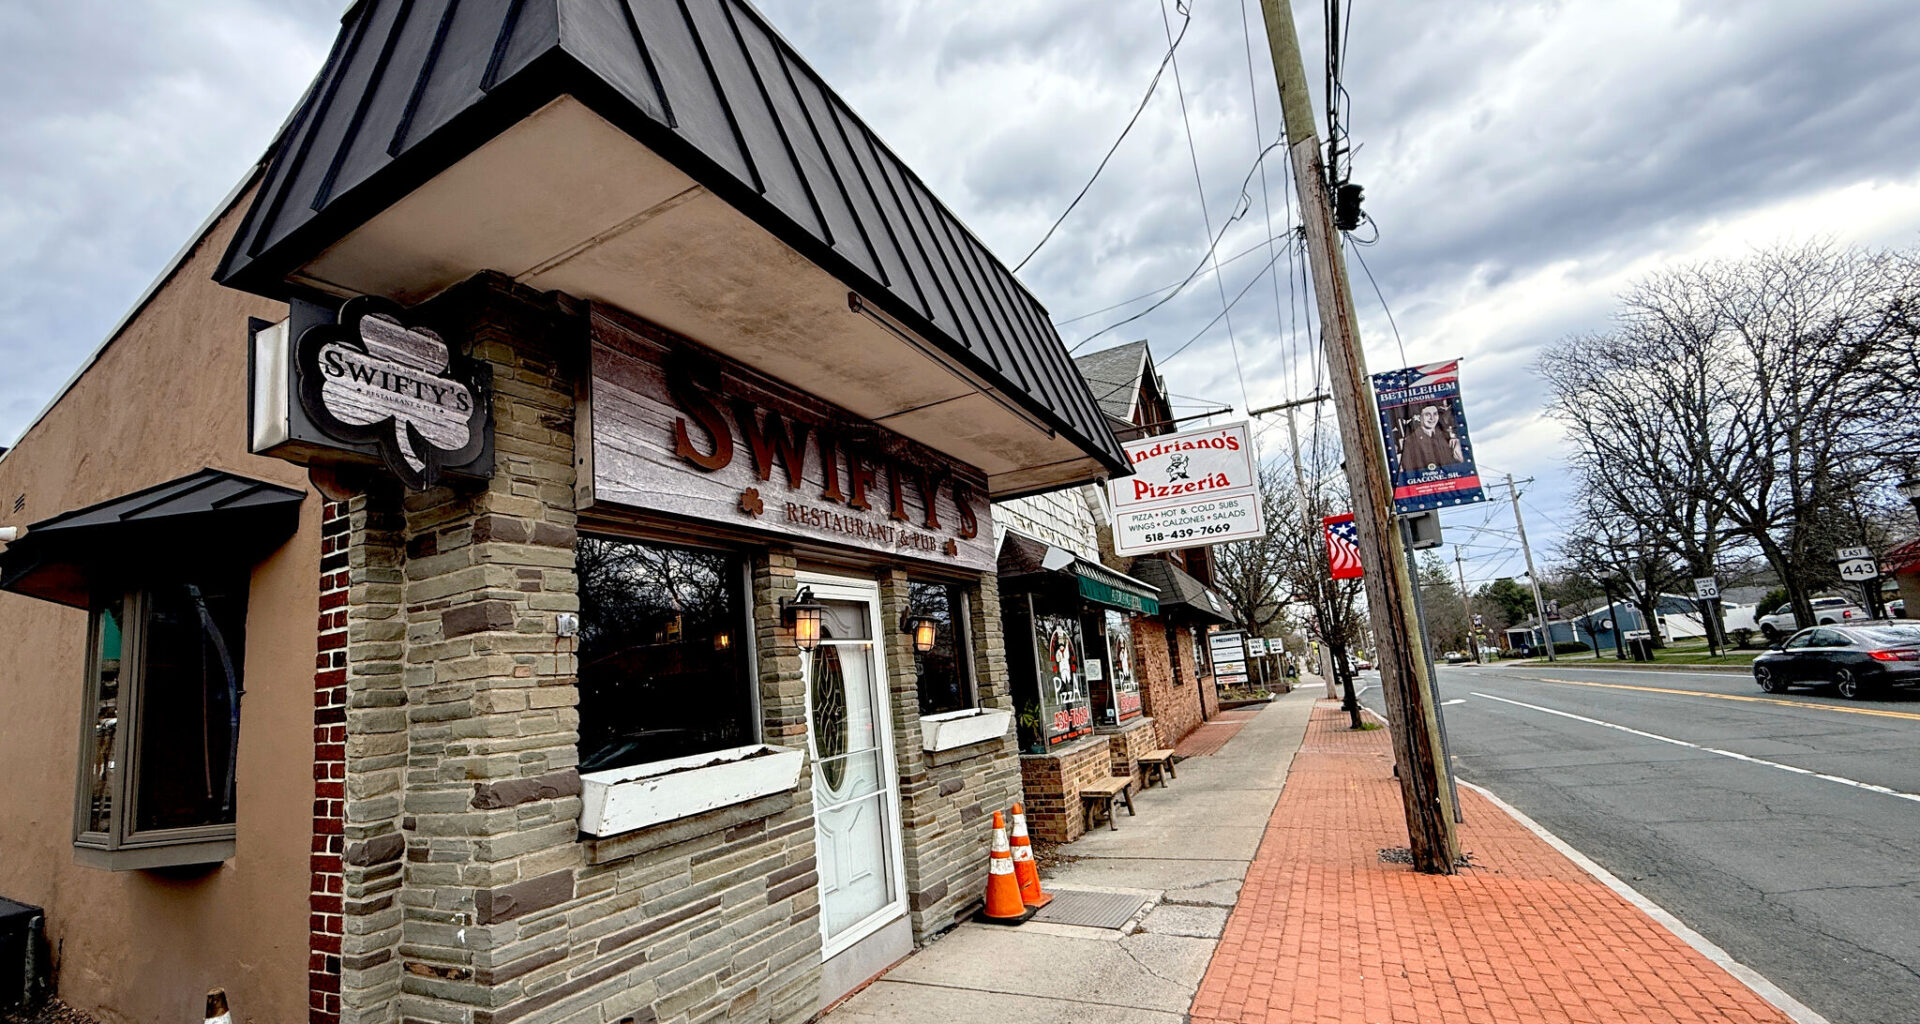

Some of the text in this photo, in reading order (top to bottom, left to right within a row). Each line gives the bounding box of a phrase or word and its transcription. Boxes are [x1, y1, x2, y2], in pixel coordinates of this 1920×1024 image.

[325, 350, 469, 412] SWIFTY'S
[1380, 381, 1456, 402] BETHLEHEM
[366, 390, 414, 407] RESTAURANT
[423, 404, 436, 413] PUB
[1402, 393, 1436, 404] HONORS
[1132, 472, 1231, 500] Pizzeria
[1128, 509, 1246, 533] WINGS CALZONES SALADS
[1132, 500, 1239, 522] PIZZA HOT & COLD SUBS
[786, 501, 937, 551] RESTAURANT & PUB
[1145, 523, 1231, 543] 518-439-7669
[1842, 548, 1863, 558] EAST
[1843, 563, 1875, 576] 443
[1700, 587, 1716, 597] 30
